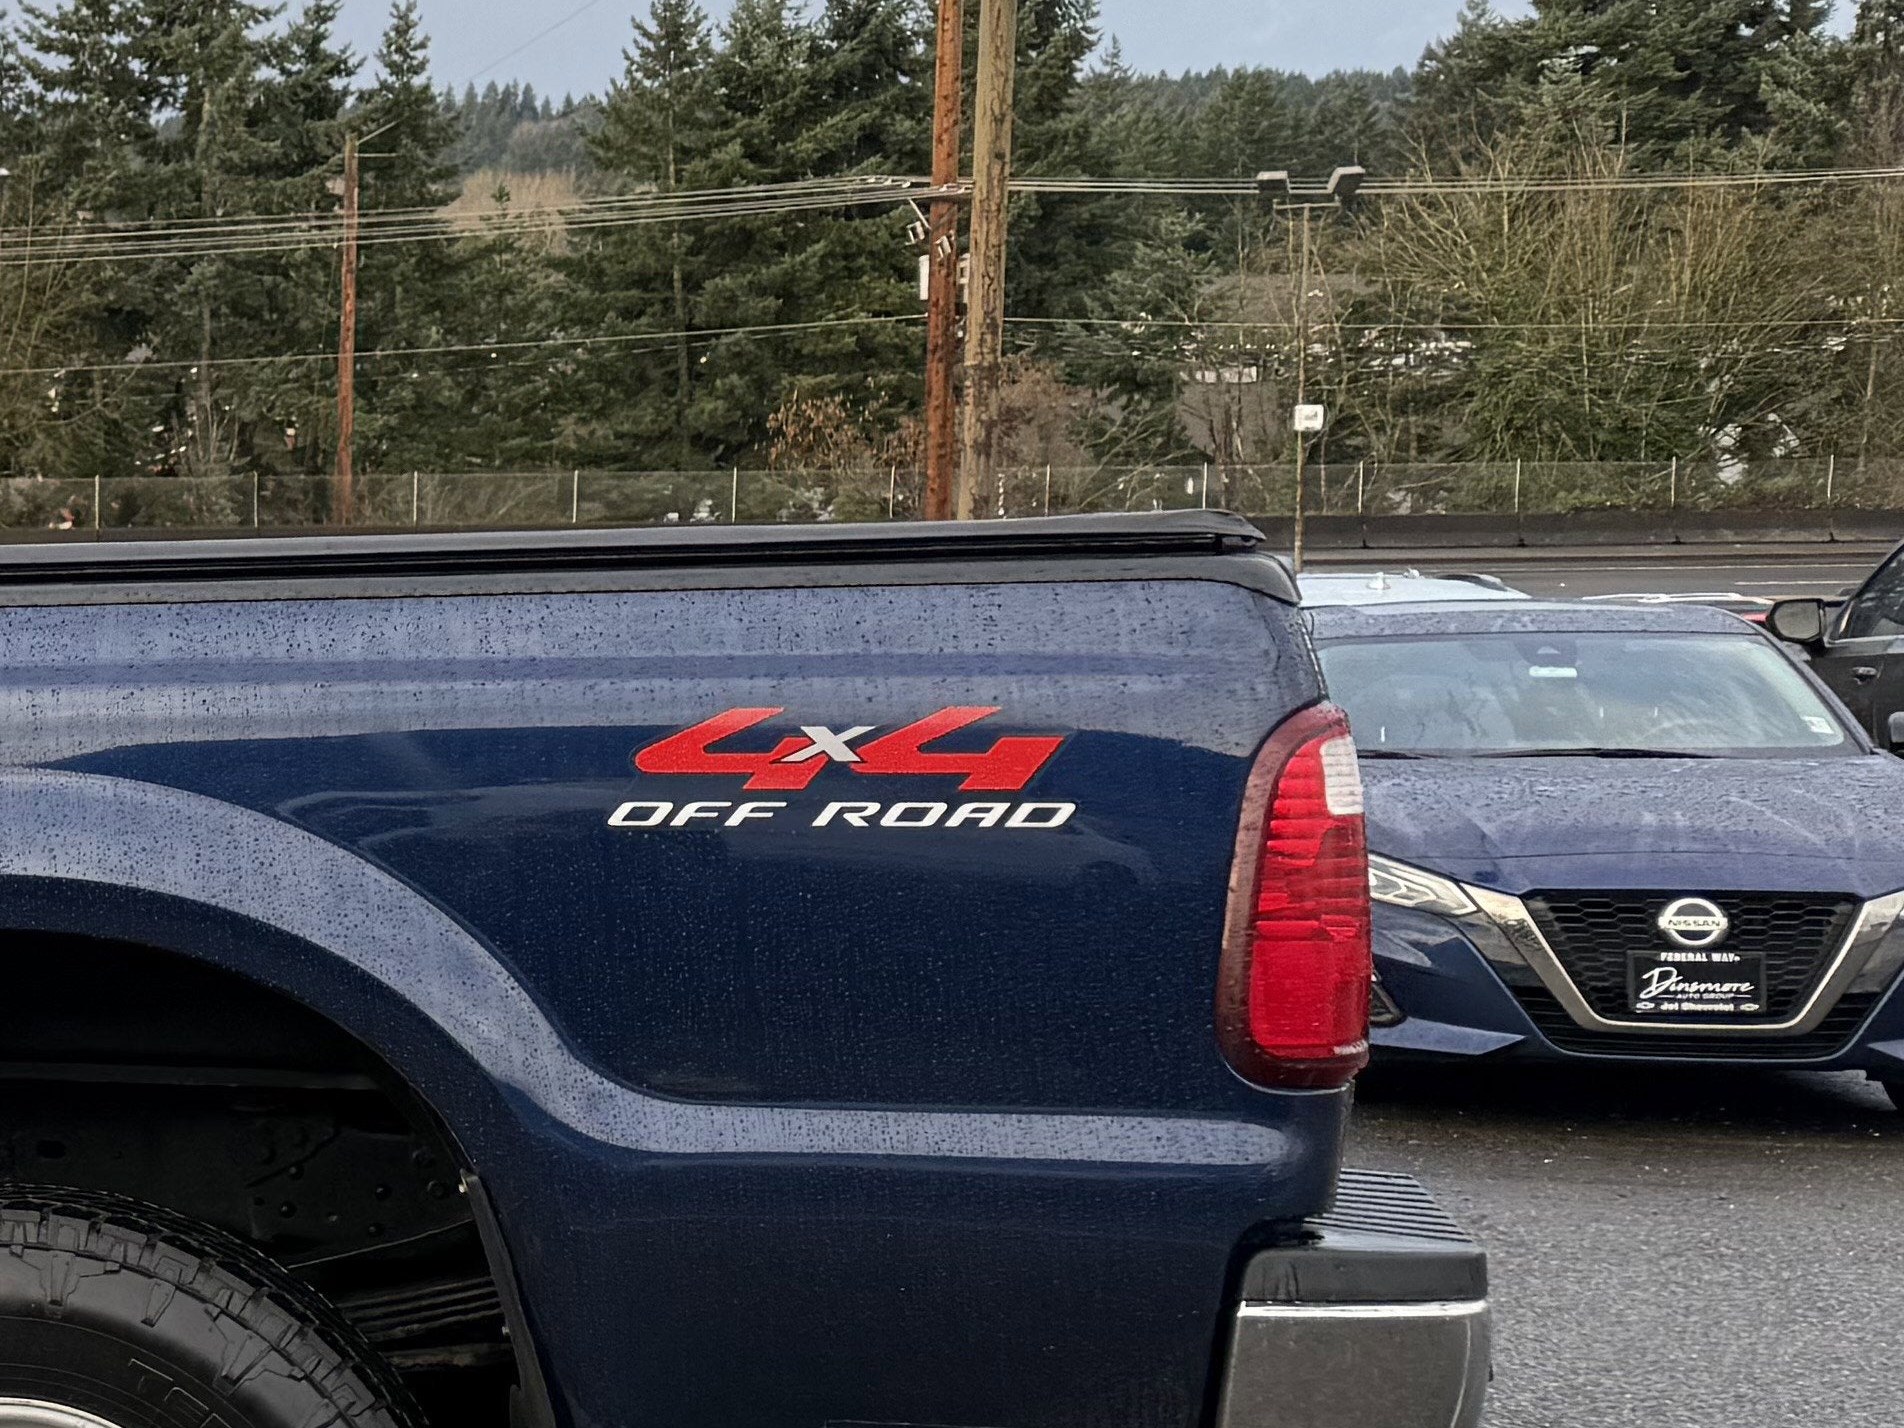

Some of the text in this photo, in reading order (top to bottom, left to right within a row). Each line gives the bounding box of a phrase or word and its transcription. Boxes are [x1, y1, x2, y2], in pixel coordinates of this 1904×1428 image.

[607, 801, 1078, 828] OFF ROAD
[1667, 919, 1721, 928] NISSAN
[1660, 952, 1709, 962] FEDERAL
[1639, 966, 1755, 999] Dinsmore
